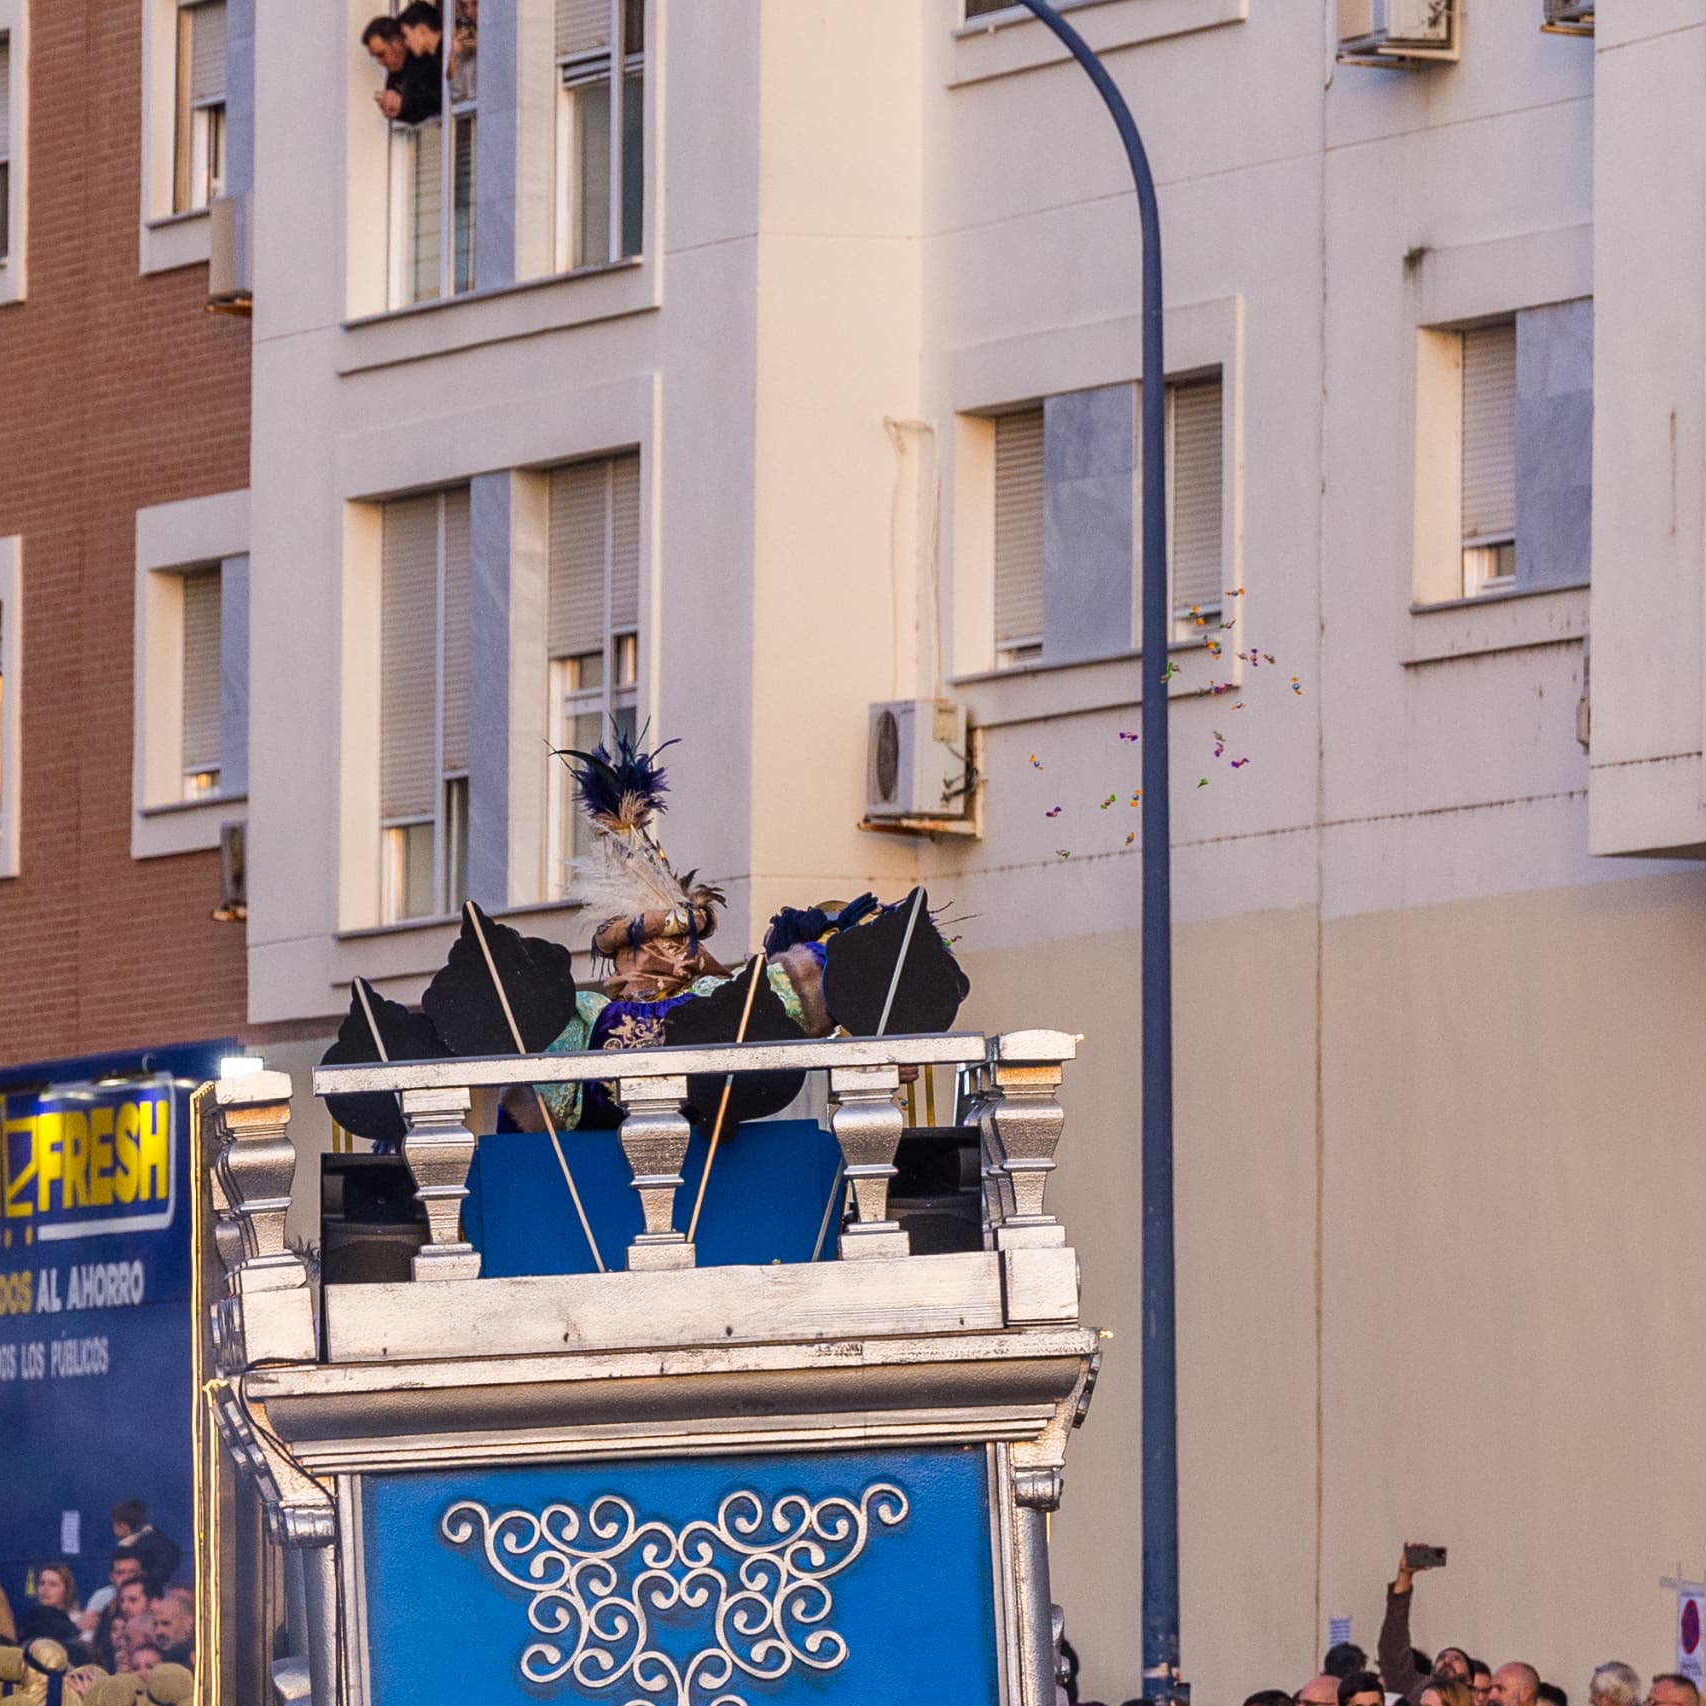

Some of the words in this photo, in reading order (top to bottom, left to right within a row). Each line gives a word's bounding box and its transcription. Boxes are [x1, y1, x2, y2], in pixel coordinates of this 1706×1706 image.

[38, 1100, 170, 1213] FRESH
[36, 1267, 62, 1314] AL
[66, 1259, 145, 1312] AHORRO
[21, 1341, 46, 1380] LOS
